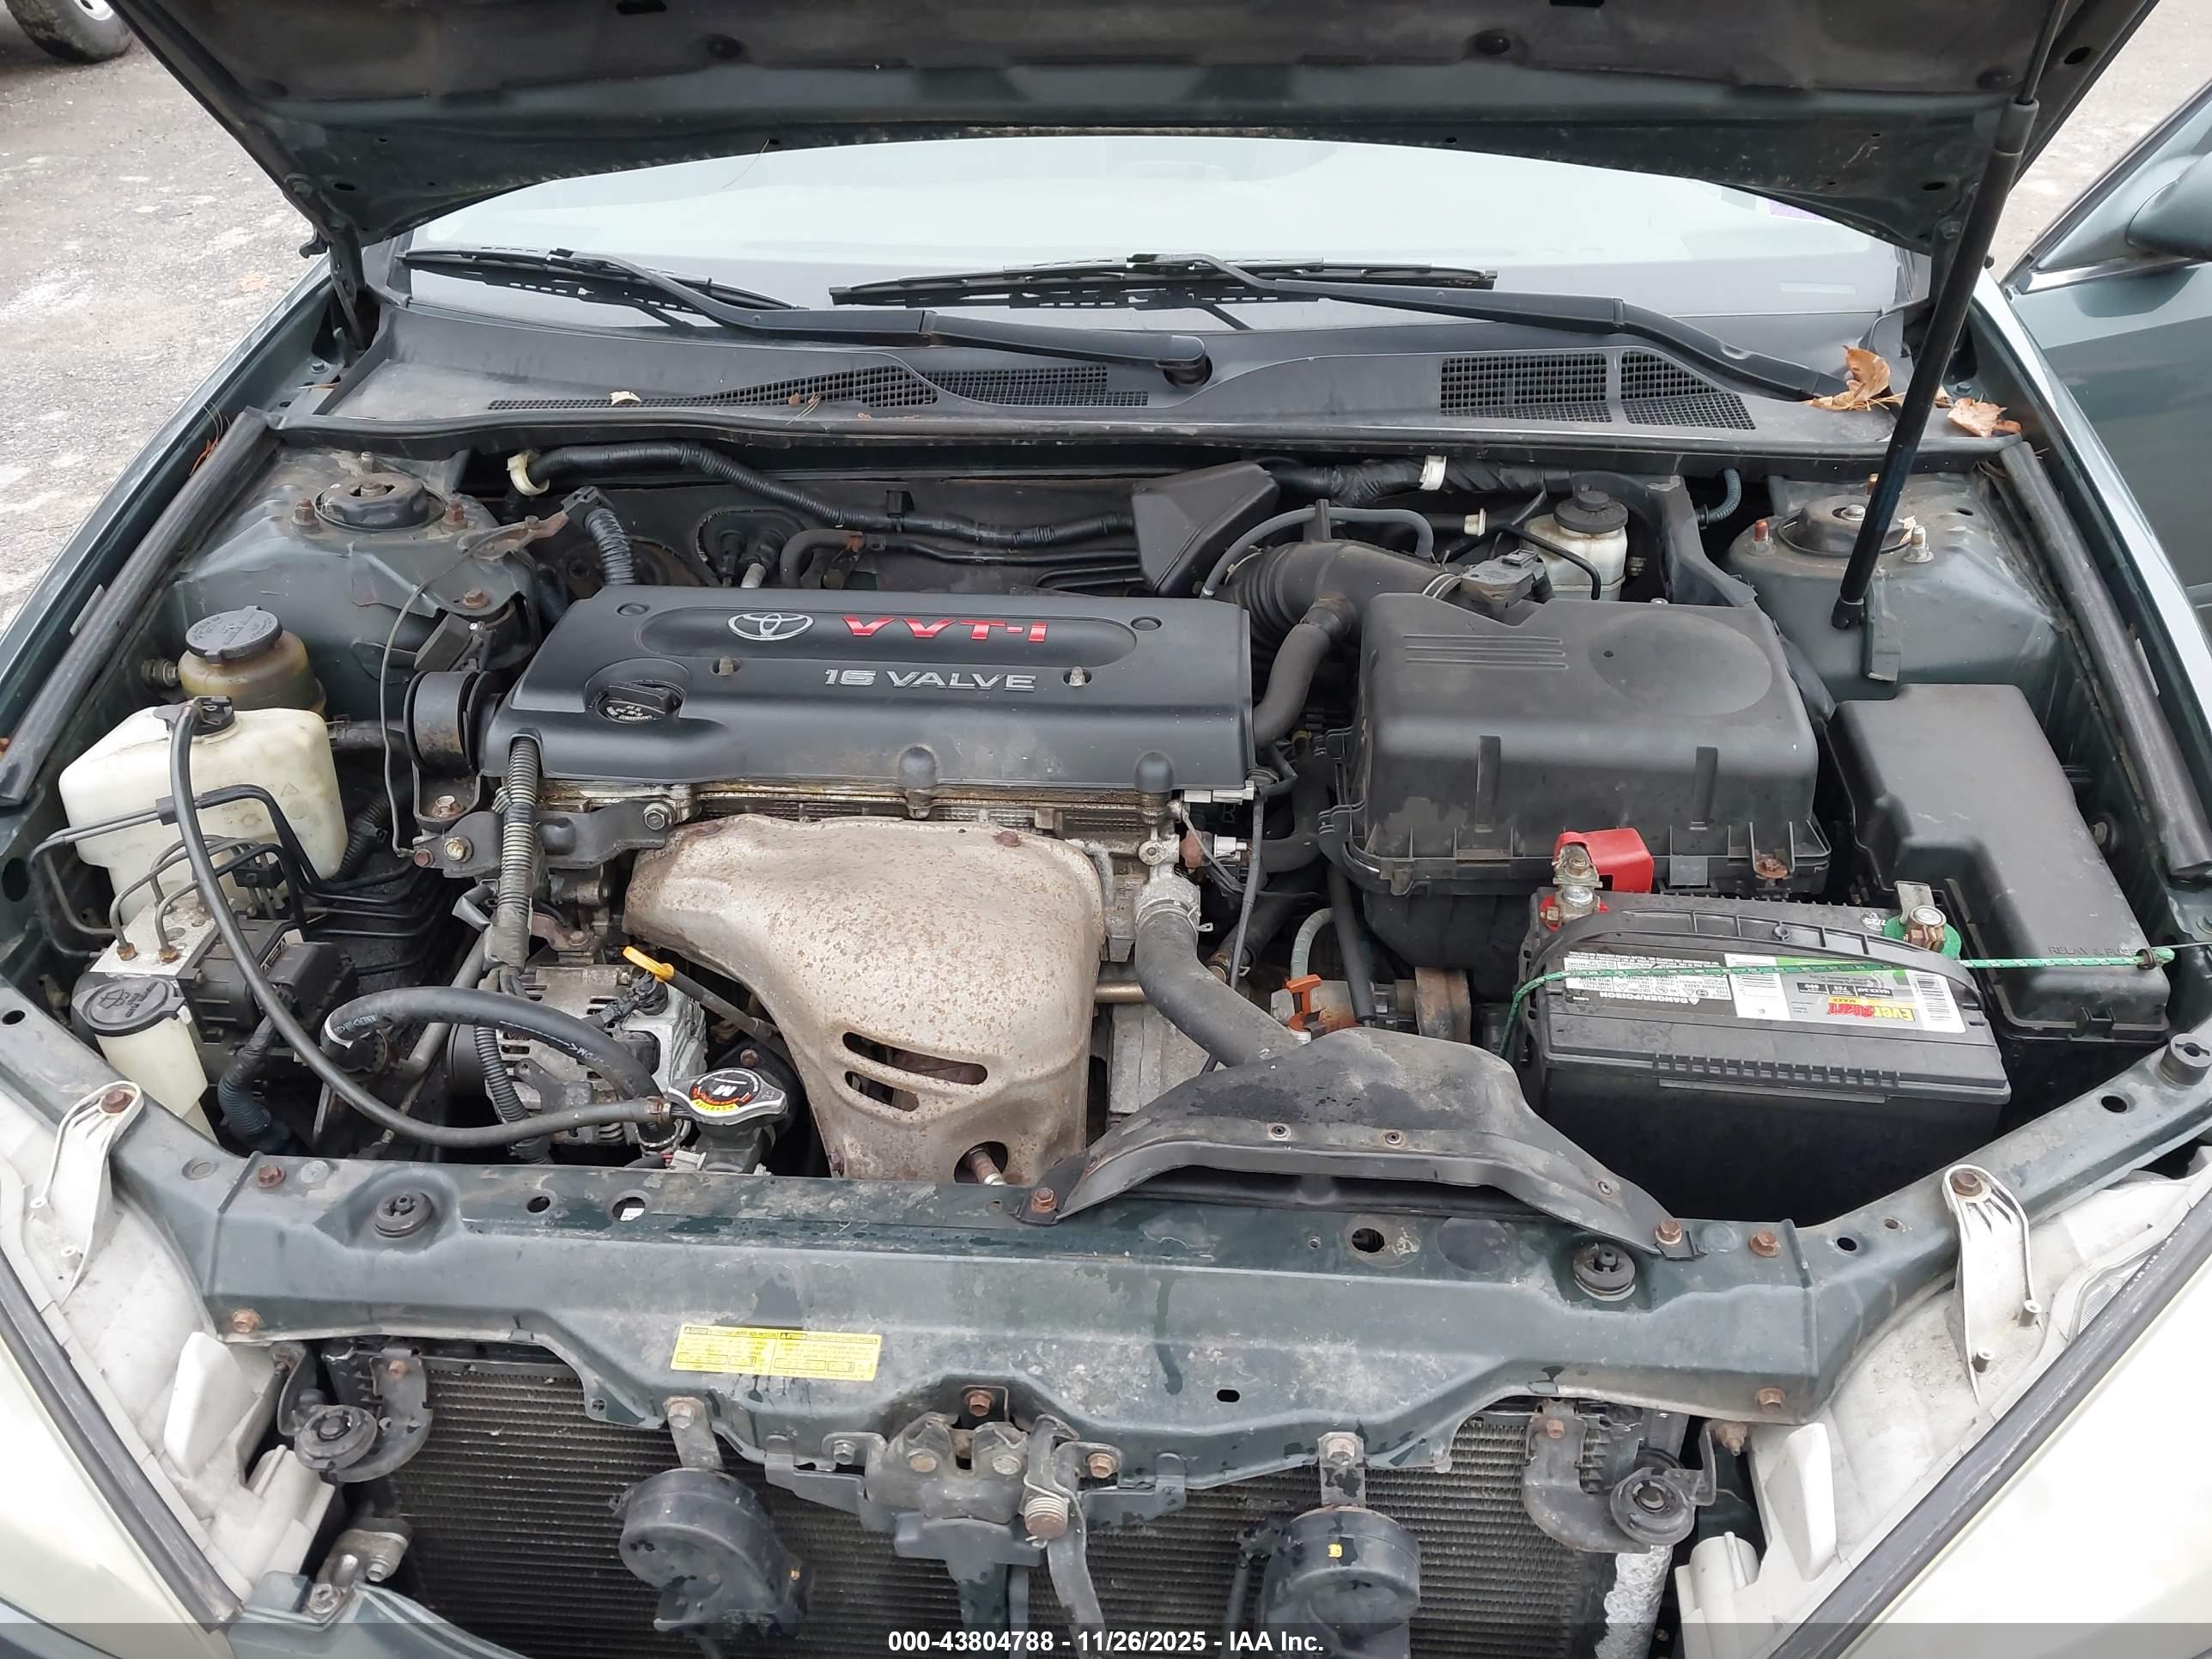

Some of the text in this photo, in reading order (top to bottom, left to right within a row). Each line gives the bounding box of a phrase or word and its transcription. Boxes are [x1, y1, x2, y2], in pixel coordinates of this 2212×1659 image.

[824, 669, 1037, 692] 16 VALVE
[2048, 946, 2087, 956] RELAY
[1600, 992, 1689, 1004] DANGER/POISON
[1827, 1004, 1914, 1022] EverStart
